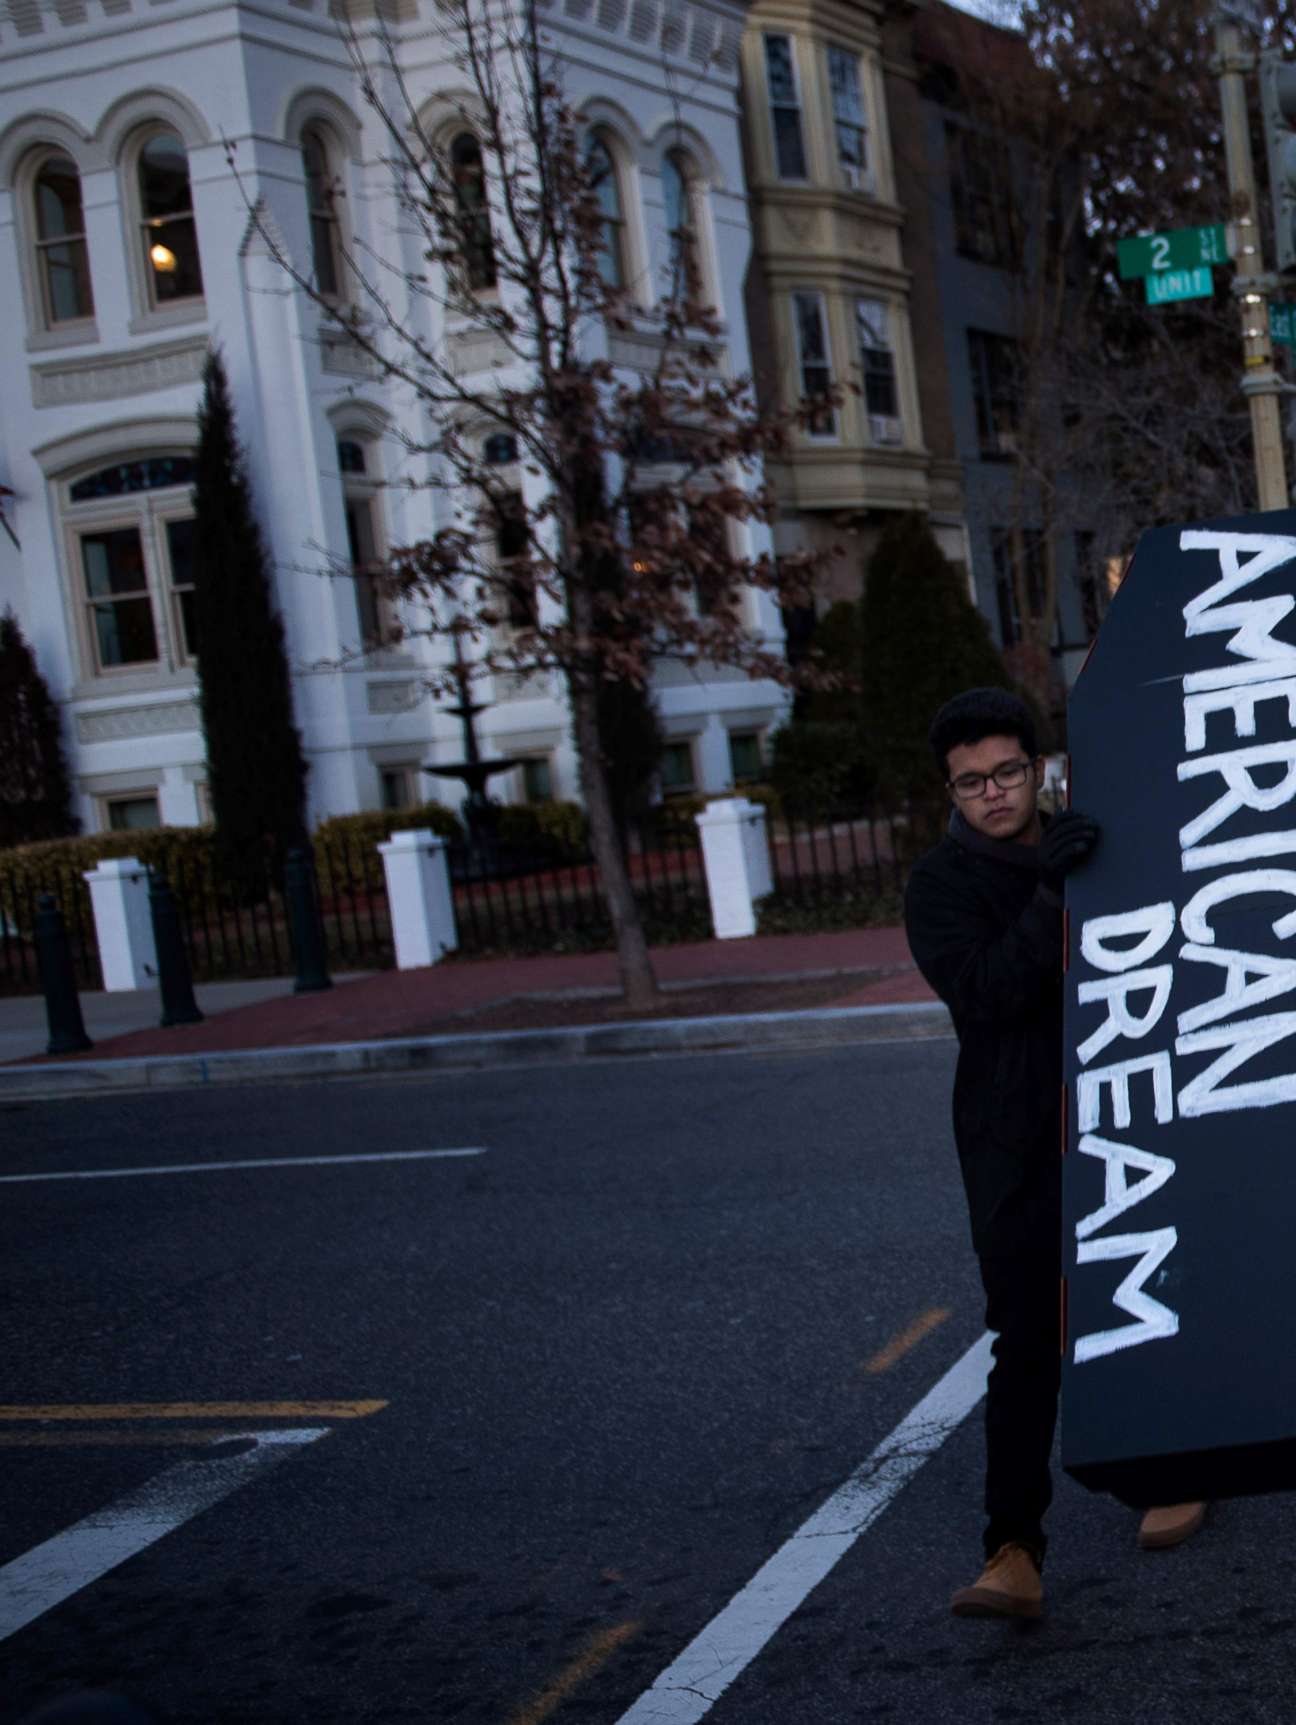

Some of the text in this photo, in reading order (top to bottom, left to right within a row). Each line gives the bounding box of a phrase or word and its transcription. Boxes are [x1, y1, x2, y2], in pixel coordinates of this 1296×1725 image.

[1150, 236, 1172, 270] 2
[1152, 269, 1202, 299] UNIT
[1073, 901, 1179, 1364] DREAM
